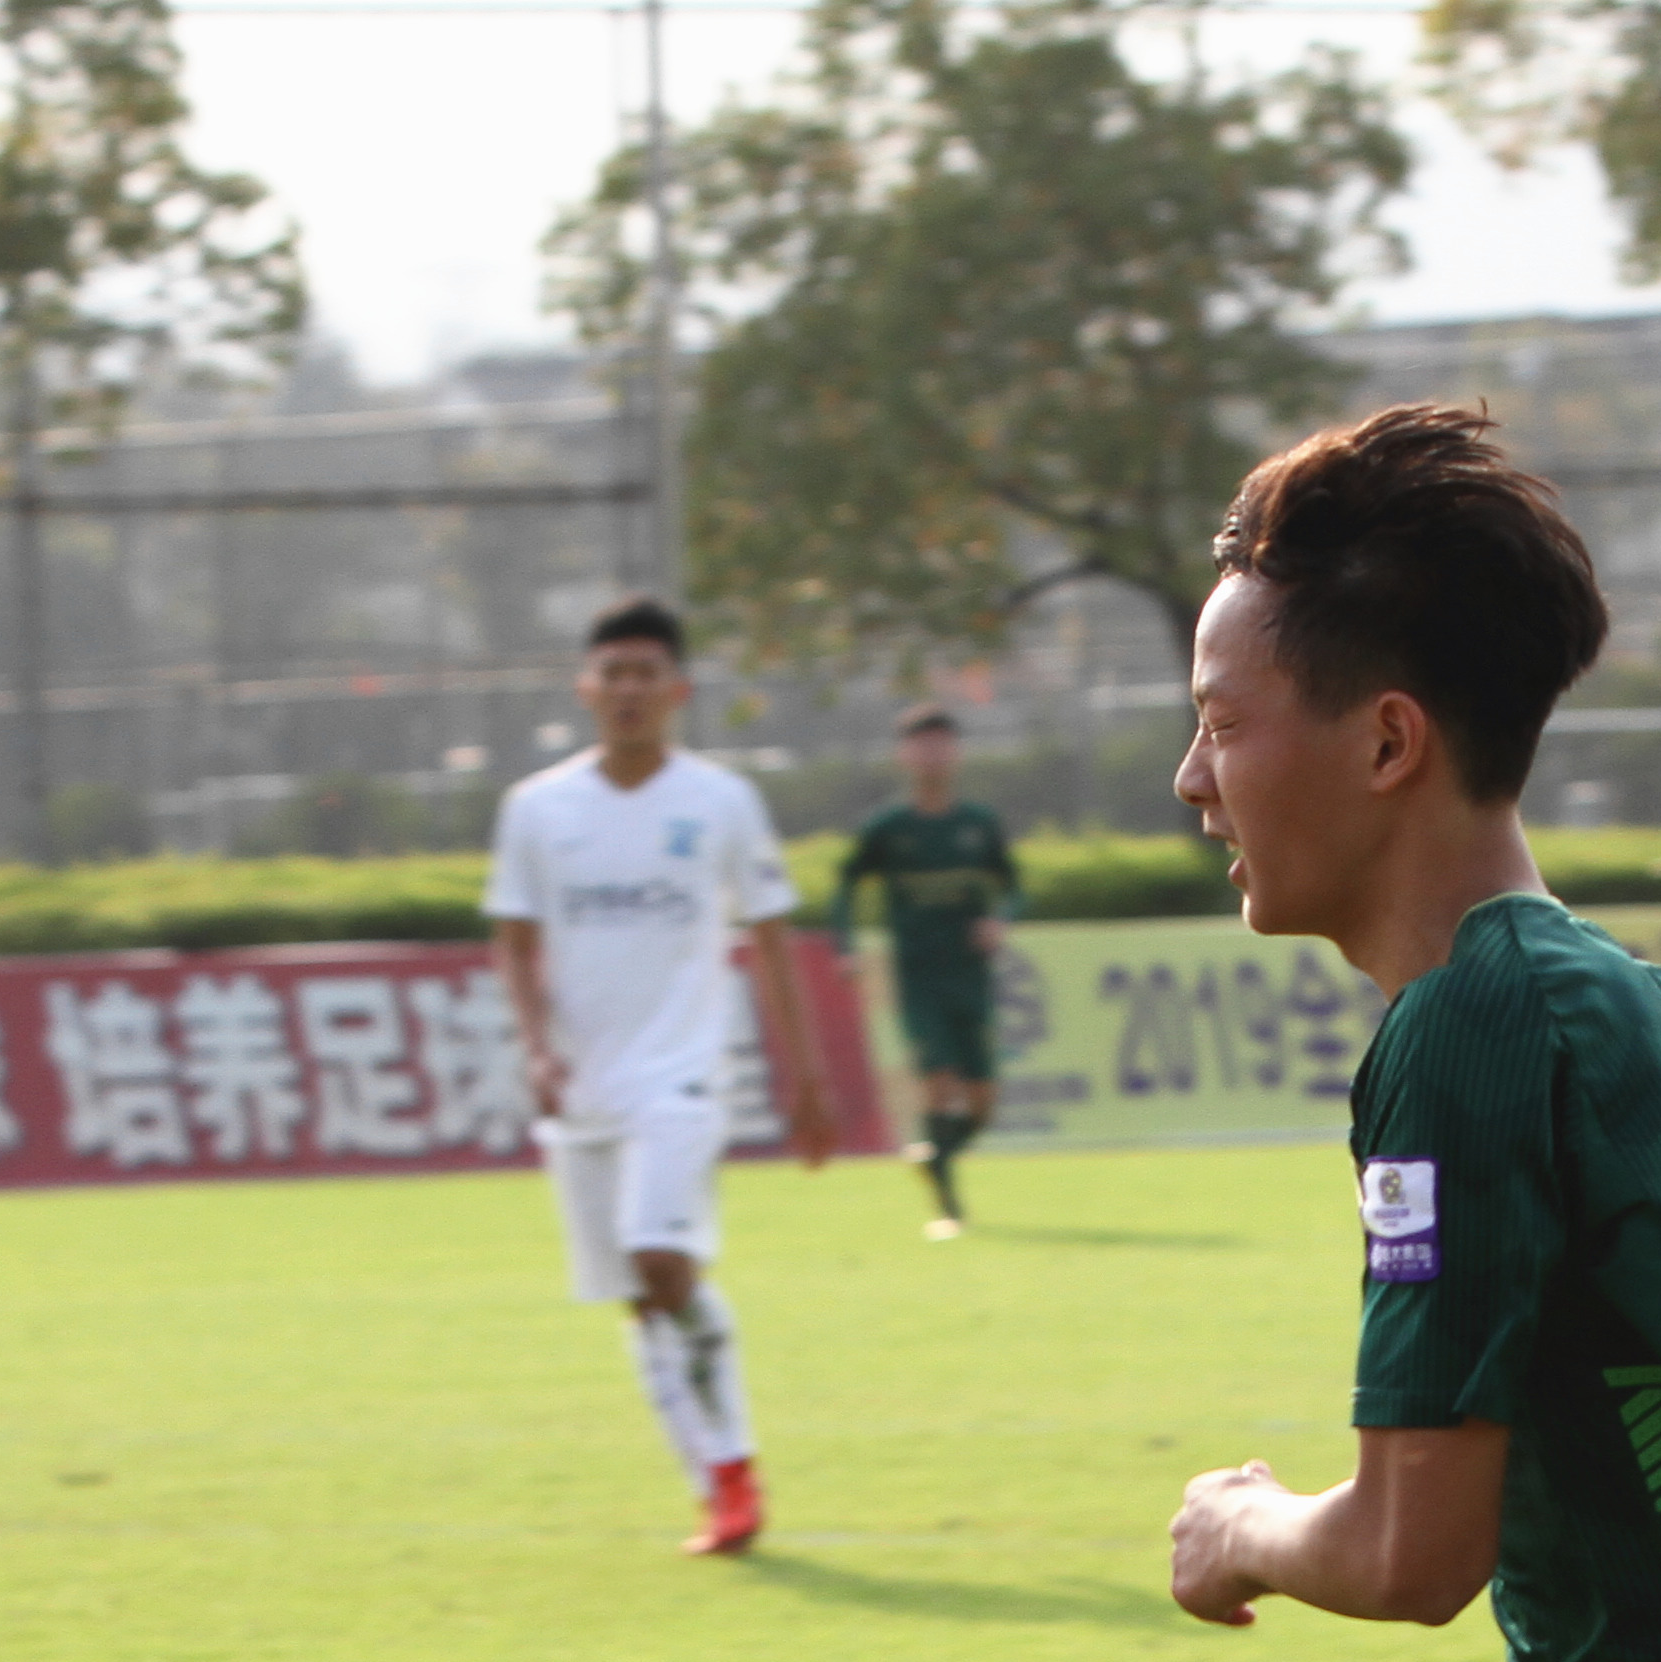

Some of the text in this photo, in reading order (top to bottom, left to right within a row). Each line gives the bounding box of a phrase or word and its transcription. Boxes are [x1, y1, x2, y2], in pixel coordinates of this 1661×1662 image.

[44, 972, 786, 1170] 培养足球
[1098, 945, 1388, 1099] 2019全
